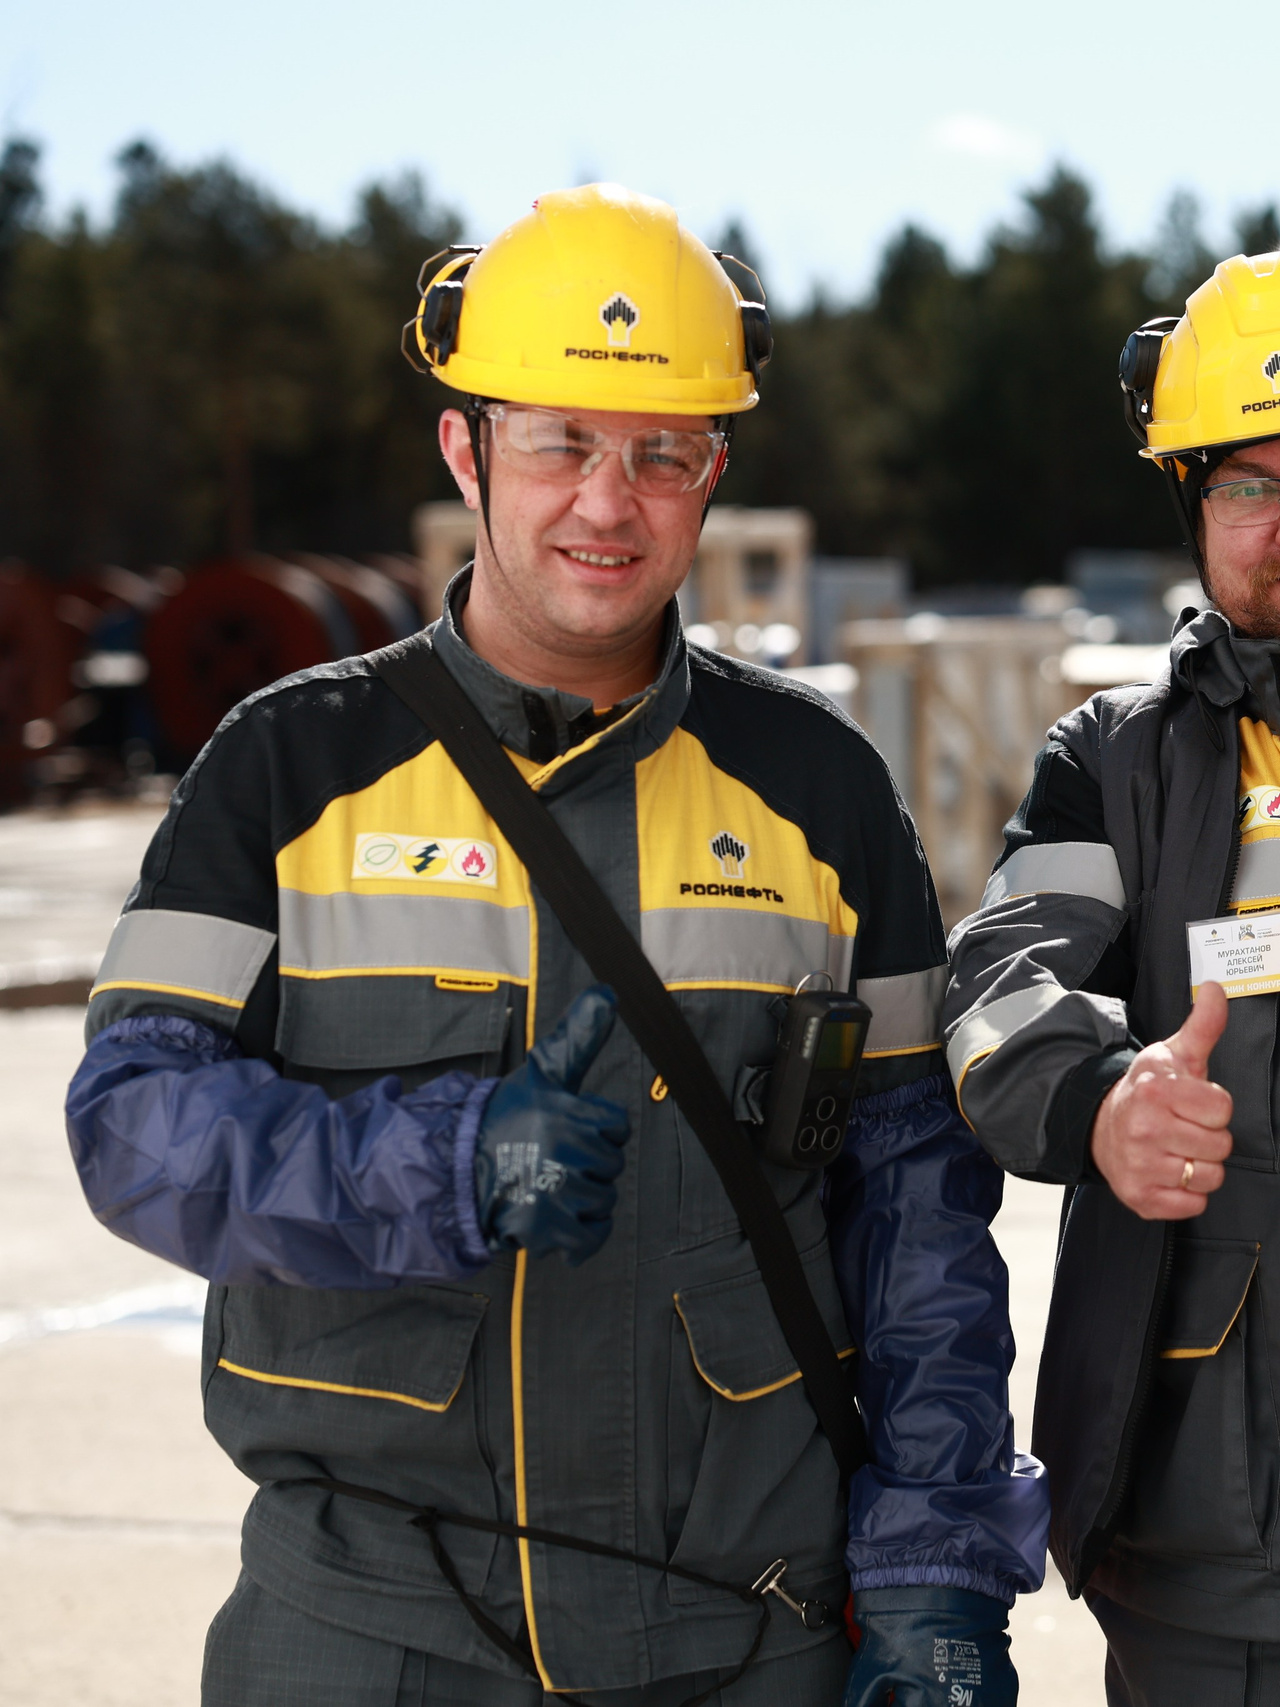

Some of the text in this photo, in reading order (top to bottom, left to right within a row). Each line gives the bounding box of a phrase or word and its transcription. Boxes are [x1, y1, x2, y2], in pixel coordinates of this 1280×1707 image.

[565, 347, 670, 365] РОСНЕФТЬ
[680, 883, 784, 903] РОСНЕФТЬ
[1217, 945, 1271, 958] МУРАХТАНОВ
[1227, 954, 1263, 967] АЛЕКСЕЙ
[1226, 964, 1265, 976] ЮРЬЕВИЧ
[938, 1671, 946, 1683] 9
[950, 1684, 973, 1707] MS
